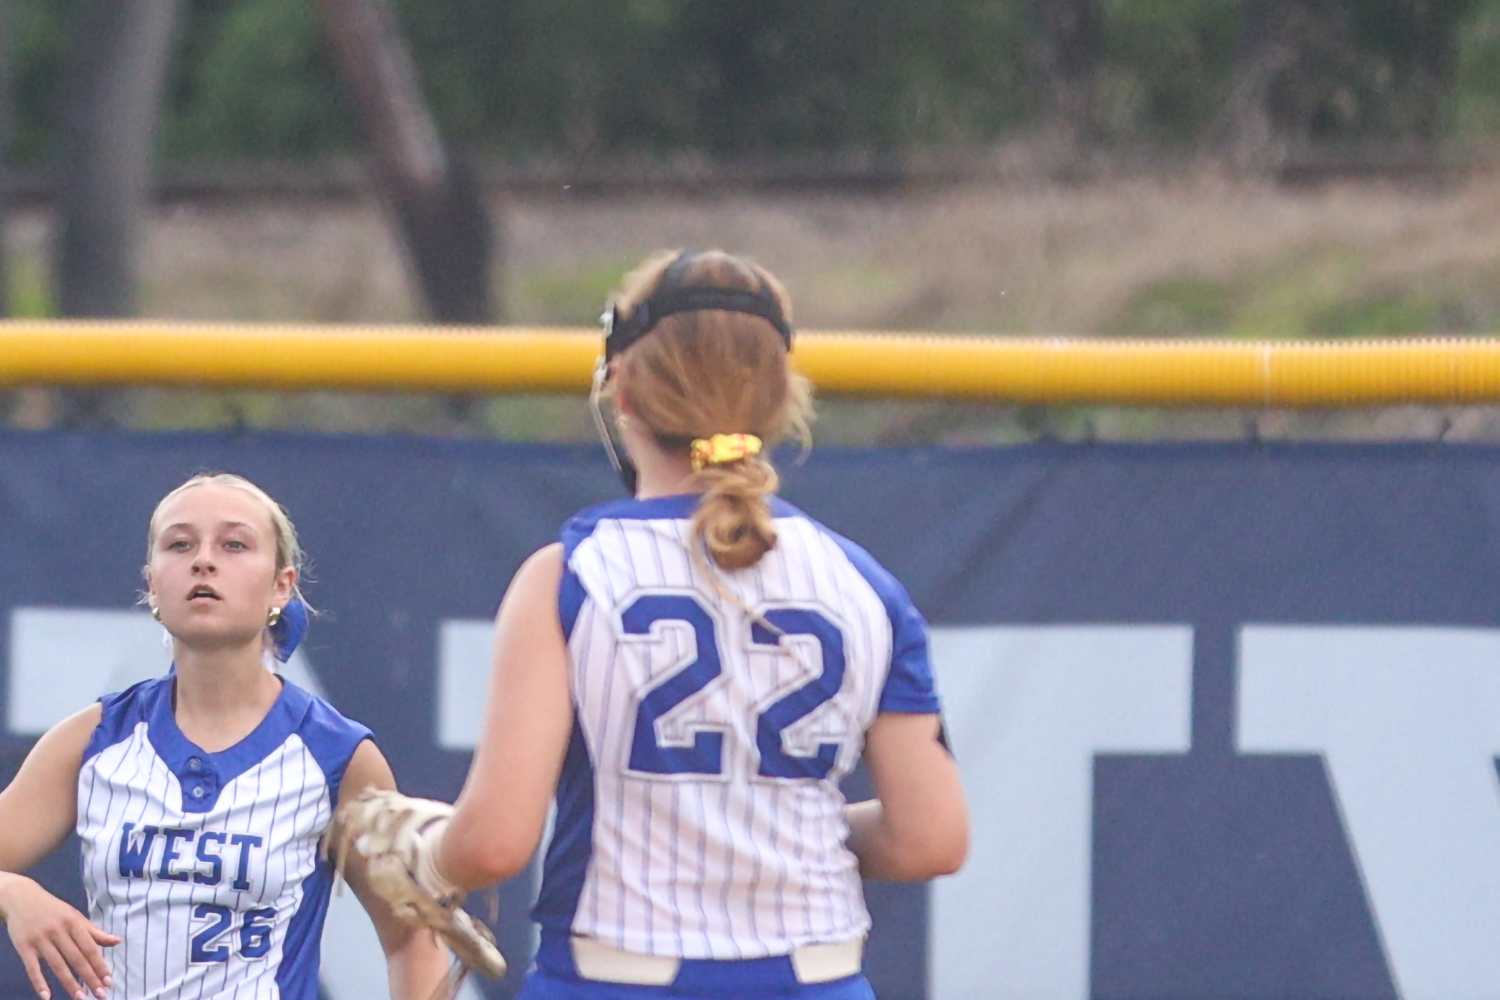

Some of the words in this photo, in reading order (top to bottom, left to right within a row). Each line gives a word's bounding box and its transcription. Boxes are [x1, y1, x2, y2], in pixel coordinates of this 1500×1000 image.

[616, 588, 850, 781] 22
[117, 822, 265, 892] WEST
[188, 903, 279, 966] 26
